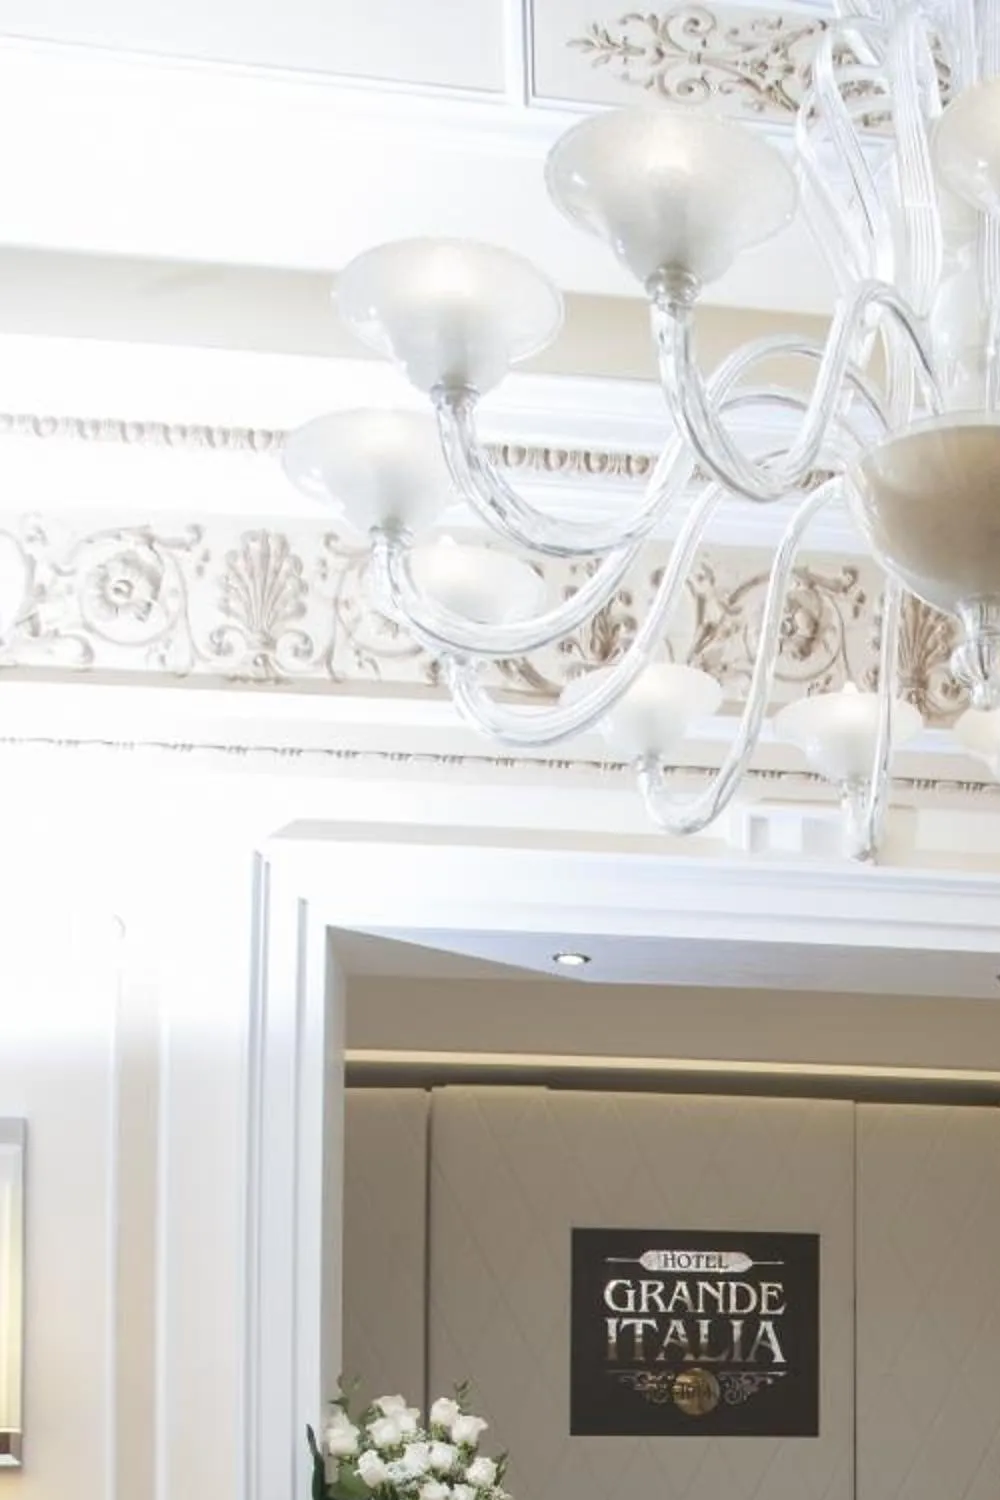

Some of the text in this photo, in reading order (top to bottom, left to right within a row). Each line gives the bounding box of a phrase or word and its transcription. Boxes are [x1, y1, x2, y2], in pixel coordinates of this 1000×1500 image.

[663, 1252, 728, 1269] HOTEL
[603, 1279, 786, 1315] GRANDE
[605, 1318, 787, 1363] ITALIA
